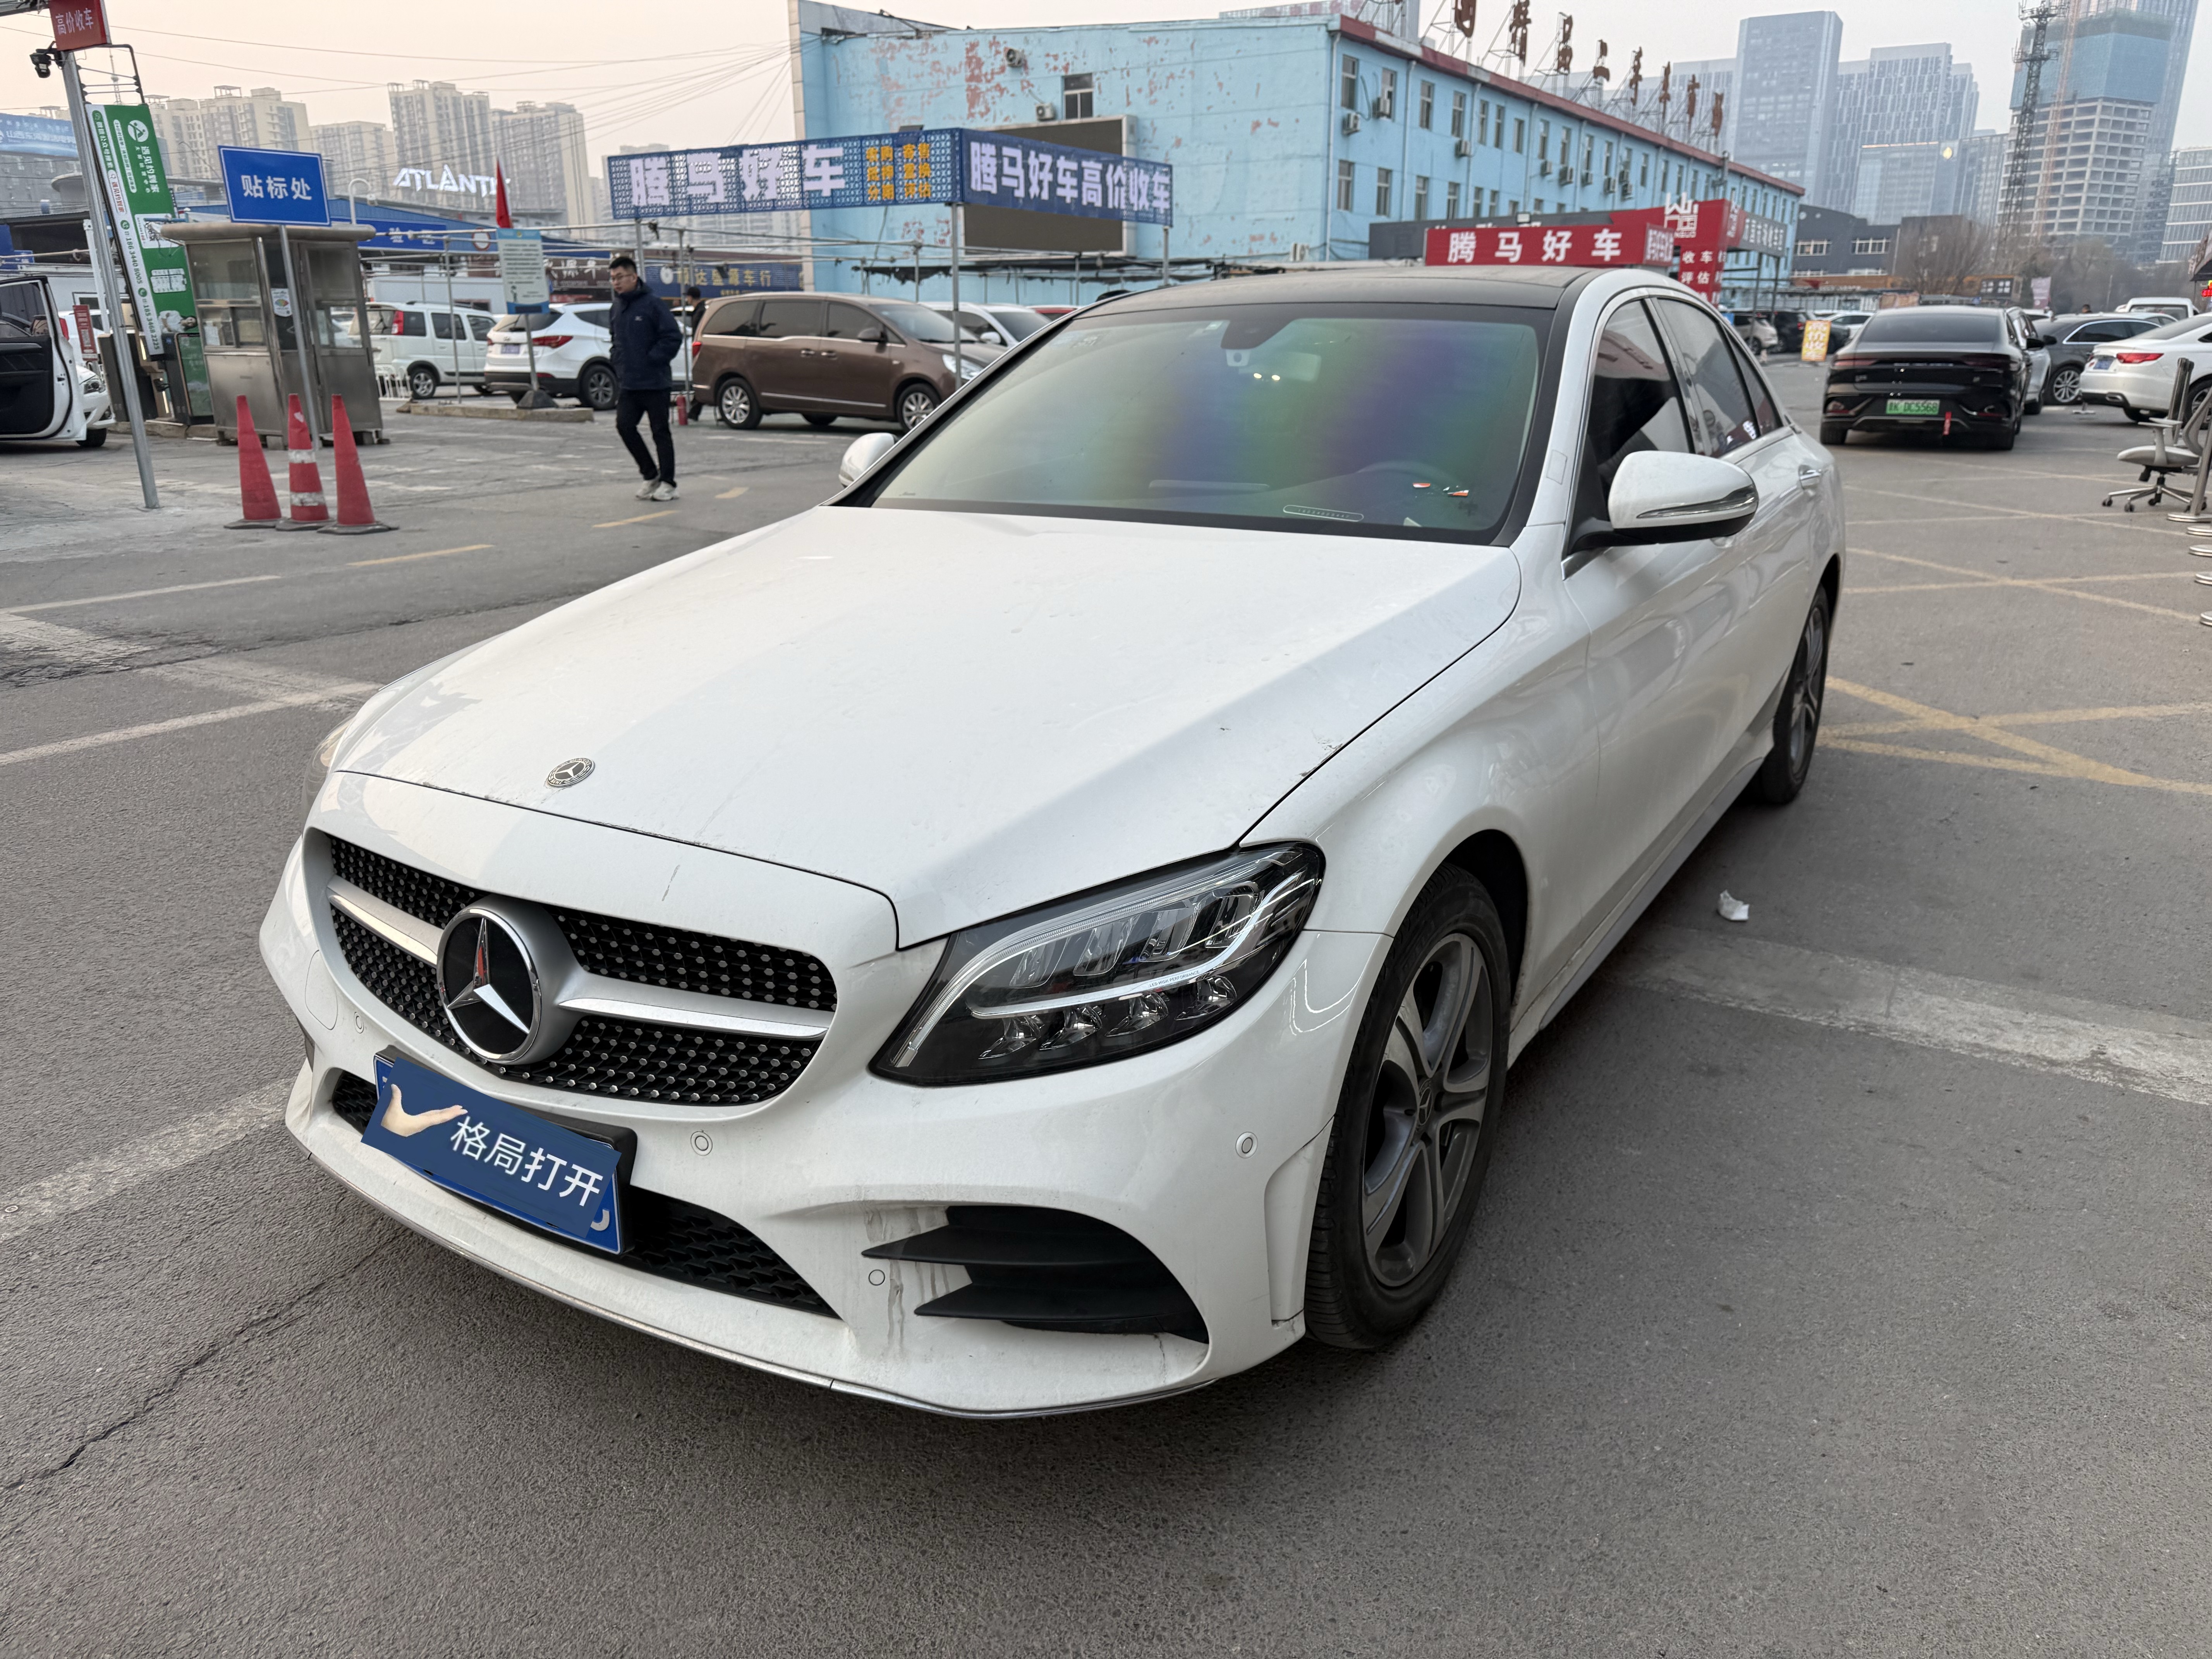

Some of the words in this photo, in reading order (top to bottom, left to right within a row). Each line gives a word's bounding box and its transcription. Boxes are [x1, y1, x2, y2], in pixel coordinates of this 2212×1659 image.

[55, 8, 94, 35] 高价收车
[241, 175, 312, 200] 贴标处
[393, 164, 511, 197] ATLANTI
[630, 145, 846, 206] 腾马好车
[904, 182, 931, 198] 评估
[970, 142, 1171, 215] 腾马好车高价收车
[1448, 228, 1622, 263] 腾马好车
[1170, 970, 1200, 982] PERFORMANCE
